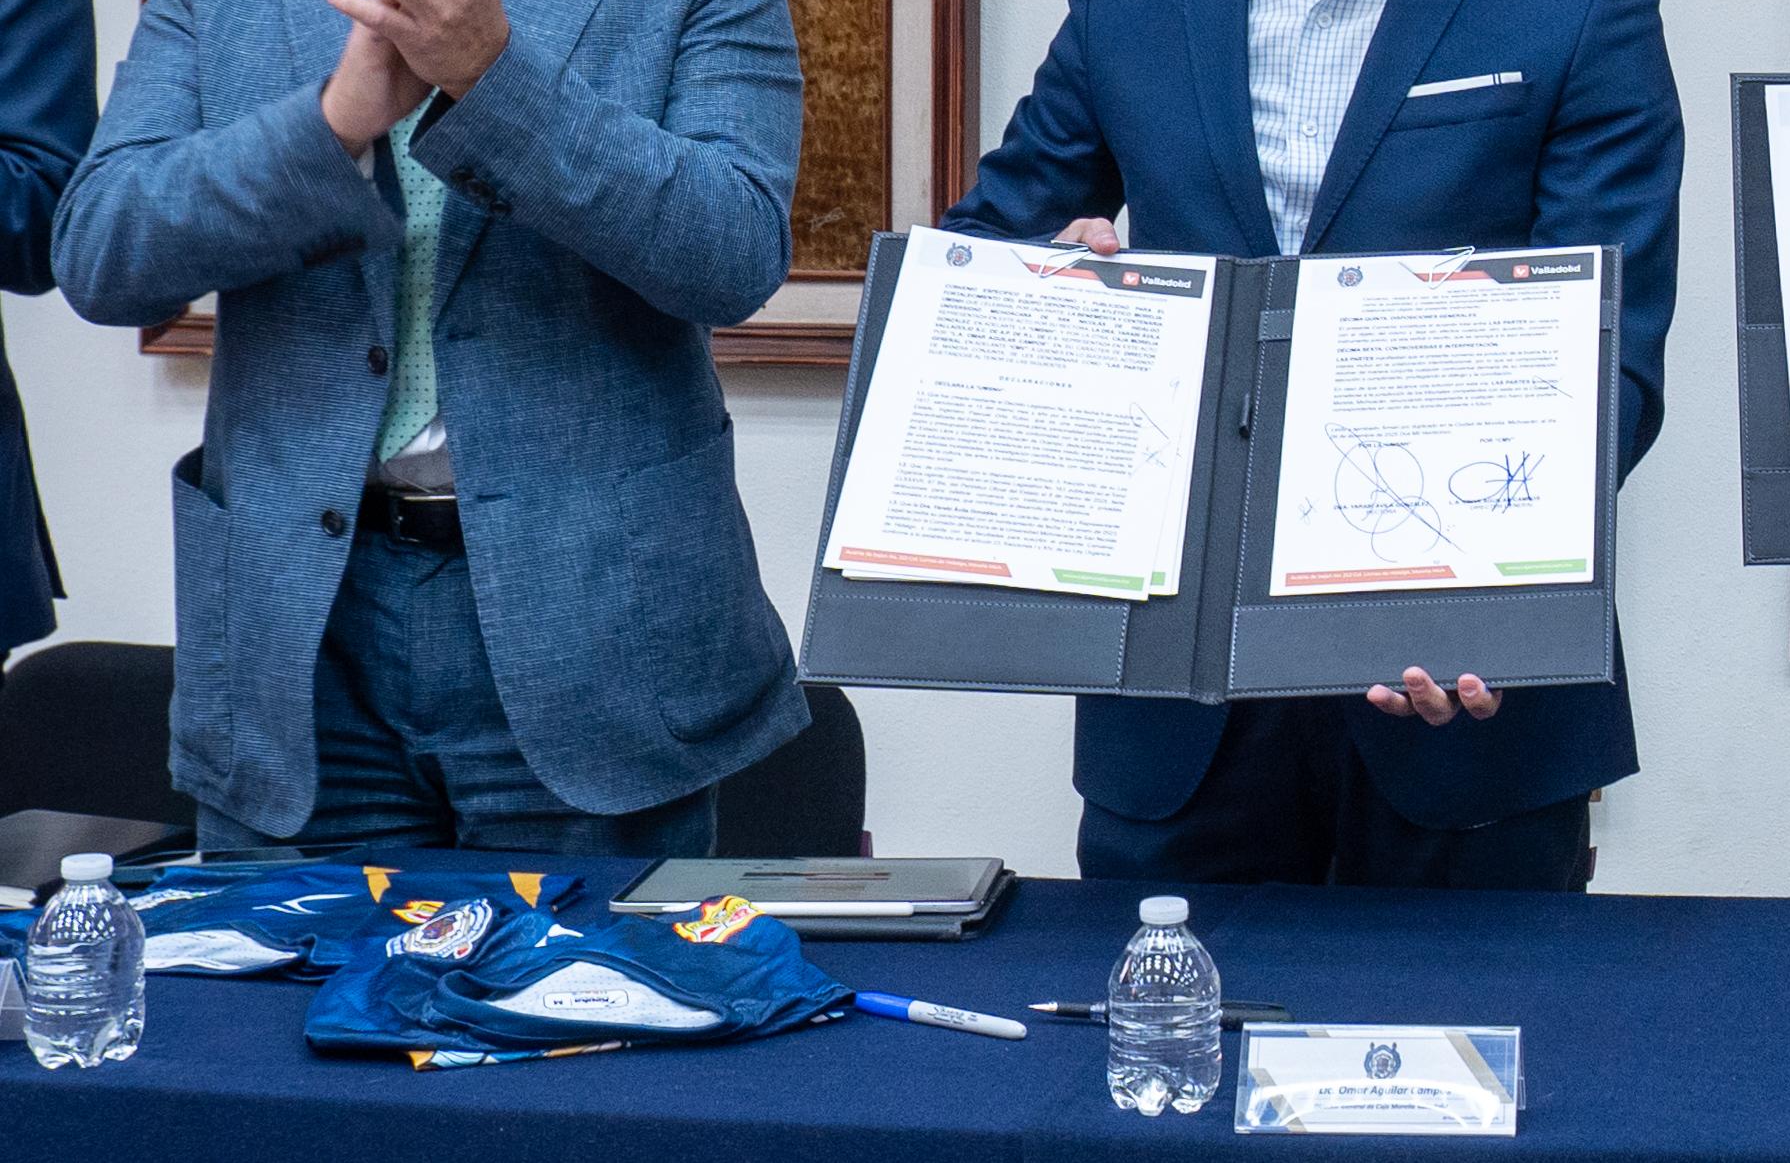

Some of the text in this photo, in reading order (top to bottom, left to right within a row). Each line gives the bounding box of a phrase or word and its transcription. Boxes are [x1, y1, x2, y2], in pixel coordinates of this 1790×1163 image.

[1530, 264, 1581, 276] Valladolid
[1140, 275, 1192, 289] Valladolid
[1410, 1085, 1452, 1096] Camp
